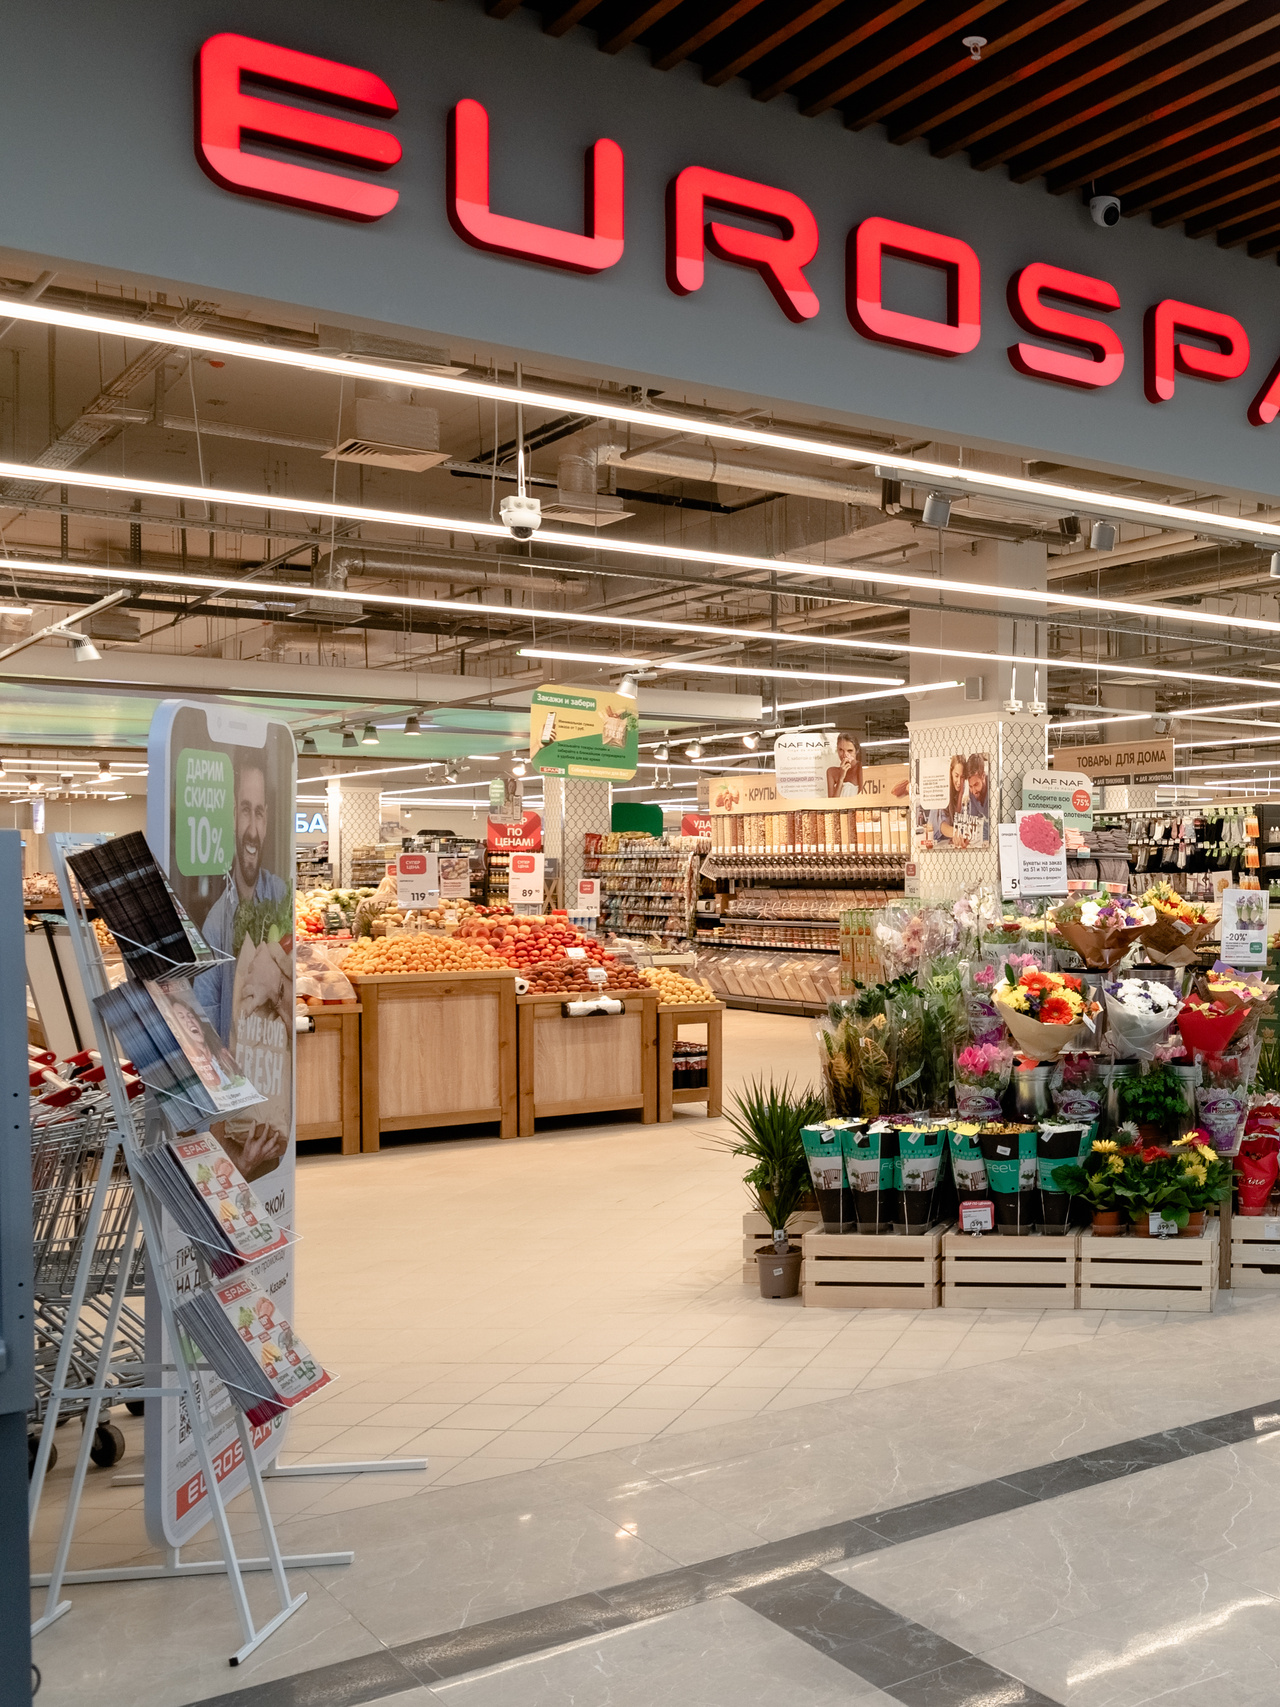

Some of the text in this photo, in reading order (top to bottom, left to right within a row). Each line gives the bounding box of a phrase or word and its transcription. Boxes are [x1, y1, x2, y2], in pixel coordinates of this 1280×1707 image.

[537, 693, 564, 704] Закажи
[570, 698, 595, 708] забери
[1077, 750, 1166, 768] ТОВАРЫ ДЛЯ ДОМА
[186, 758, 224, 783] ДАРИМ
[1032, 777, 1084, 787] NAF NAF
[184, 786, 226, 813] СКИДКУ
[748, 787, 777, 801] КРУПЫ
[1028, 793, 1057, 802] Соберите
[1073, 799, 1090, 807] -75%
[295, 812, 327, 833] БА
[1064, 812, 1092, 820] олотенец
[693, 820, 711, 829] УДА
[507, 828, 523, 837] ПО
[188, 816, 225, 864] 10%
[495, 837, 534, 847] ЦЕНАМ!
[411, 892, 426, 901] 119
[521, 889, 533, 898] 89
[235, 1042, 283, 1095] FRESH
[182, 1141, 209, 1156] SPAR
[224, 1282, 248, 1300] SPAR
